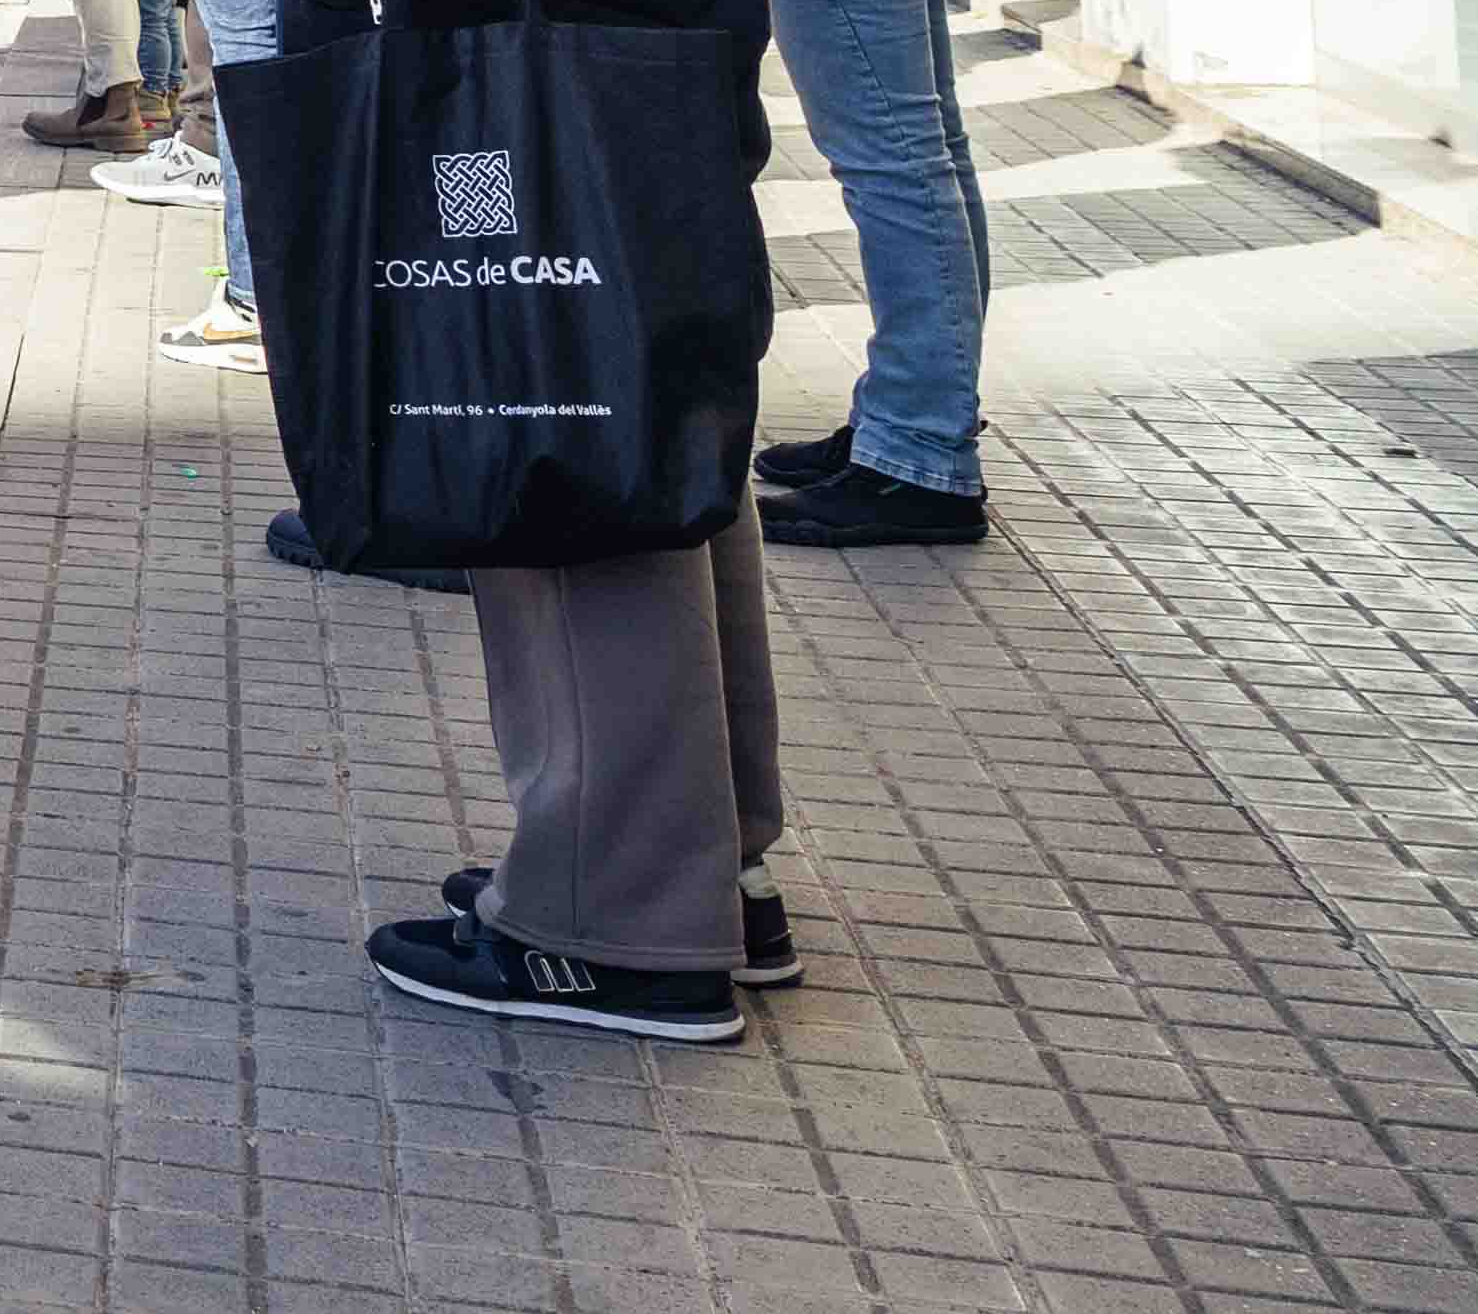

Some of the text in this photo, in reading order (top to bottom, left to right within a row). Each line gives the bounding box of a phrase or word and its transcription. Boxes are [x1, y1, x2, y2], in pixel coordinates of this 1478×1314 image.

[196, 171, 221, 187] M
[476, 256, 506, 285] de
[510, 255, 603, 286] CASA
[388, 403, 402, 416] C/
[403, 403, 430, 416] Sant
[466, 404, 483, 416] 96
[557, 403, 576, 416] del
